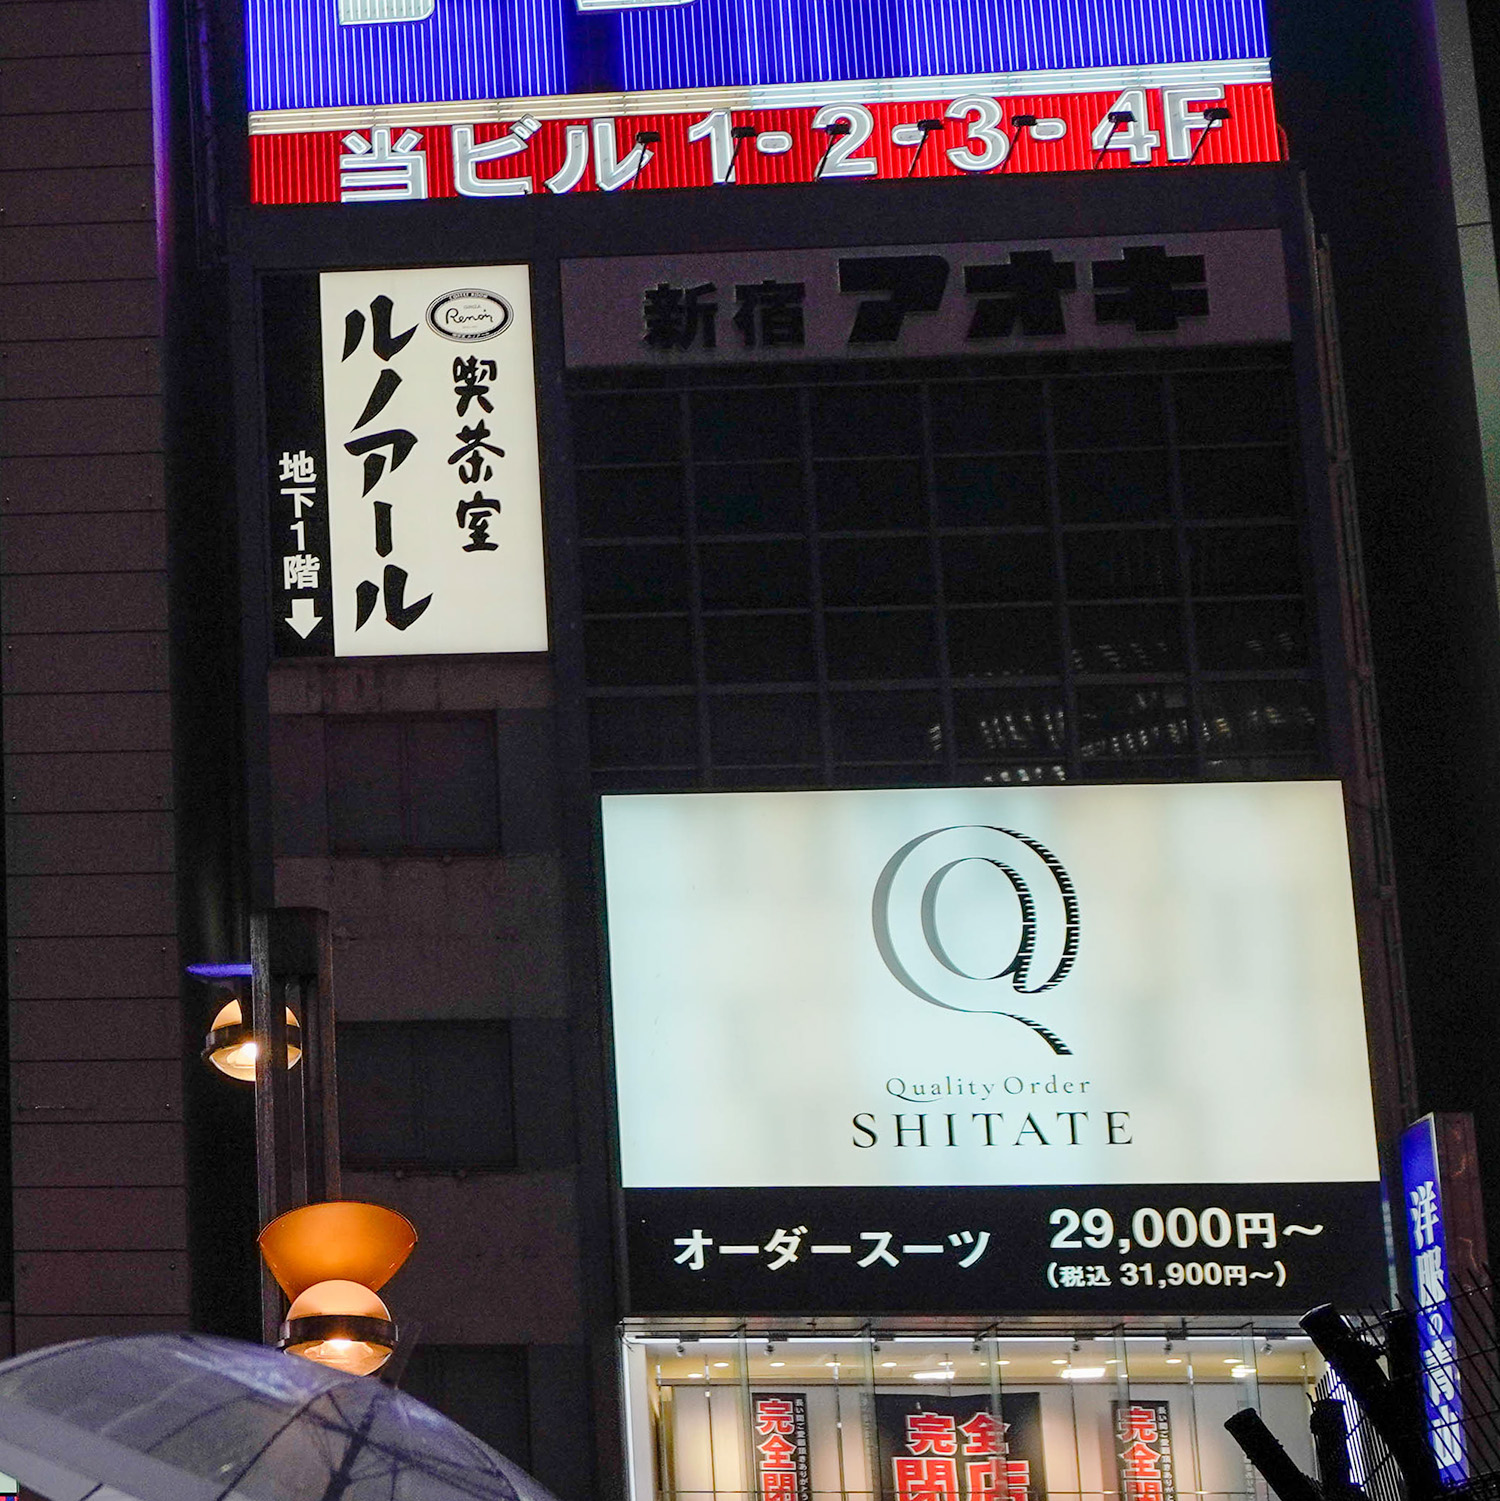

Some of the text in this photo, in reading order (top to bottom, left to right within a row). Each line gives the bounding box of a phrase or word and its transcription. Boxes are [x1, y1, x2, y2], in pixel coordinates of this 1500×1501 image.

[338, 113, 654, 203] 当ビル
[643, 245, 1211, 351] 新宿 アオキ
[341, 294, 434, 633] ルノアール
[447, 355, 506, 553] 喫茶室
[278, 450, 322, 591] 地下1階
[851, 1111, 1135, 1149] SHITATE
[885, 1073, 1093, 1103] Quality Order
[672, 1224, 992, 1273] オーダースーツ
[904, 1411, 1012, 1457] 完全
